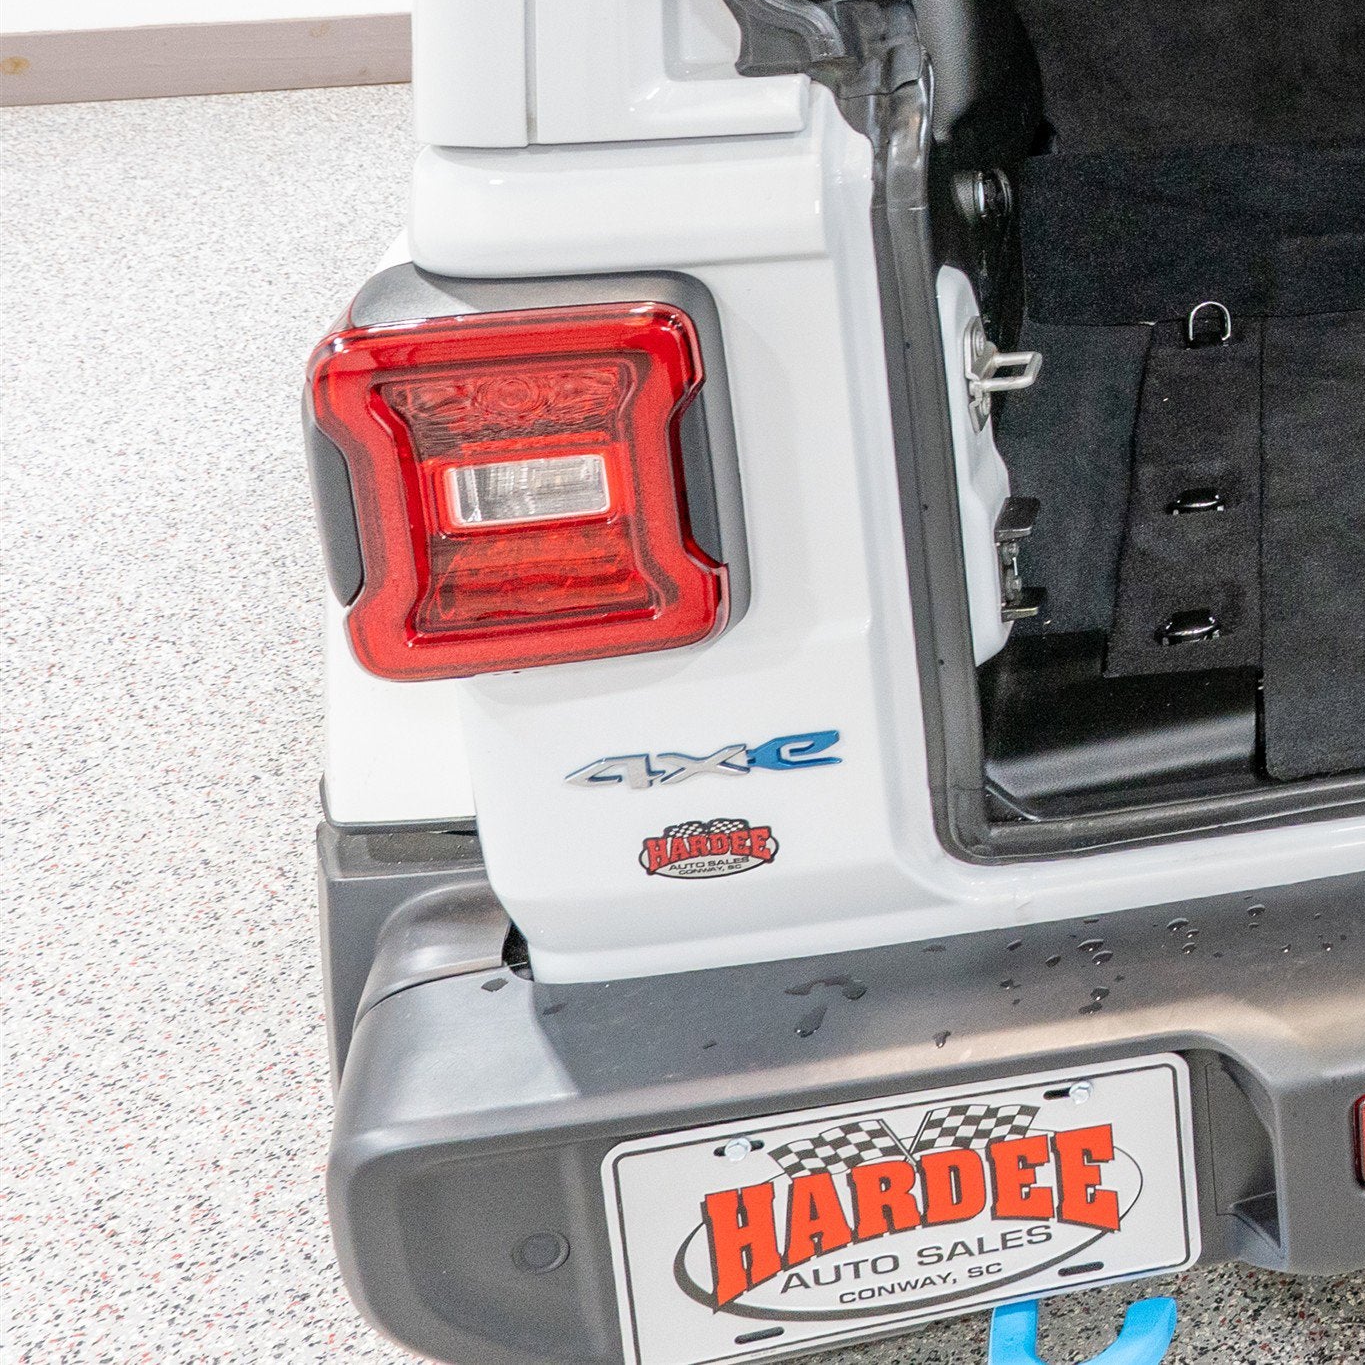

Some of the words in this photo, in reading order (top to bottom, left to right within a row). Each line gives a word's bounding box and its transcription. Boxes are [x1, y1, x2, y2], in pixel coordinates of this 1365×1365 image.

[645, 826, 773, 873] HARDEE
[669, 861, 706, 871] AUTO
[707, 856, 750, 868] SALES
[678, 866, 726, 876] CONWAY,
[727, 863, 742, 871] SC
[703, 1124, 1121, 1313] HARDEE
[780, 1254, 899, 1294] AUTO
[916, 1224, 1053, 1266] SALES
[838, 1272, 959, 1305] CONWAY,
[967, 1261, 1003, 1279] SC
